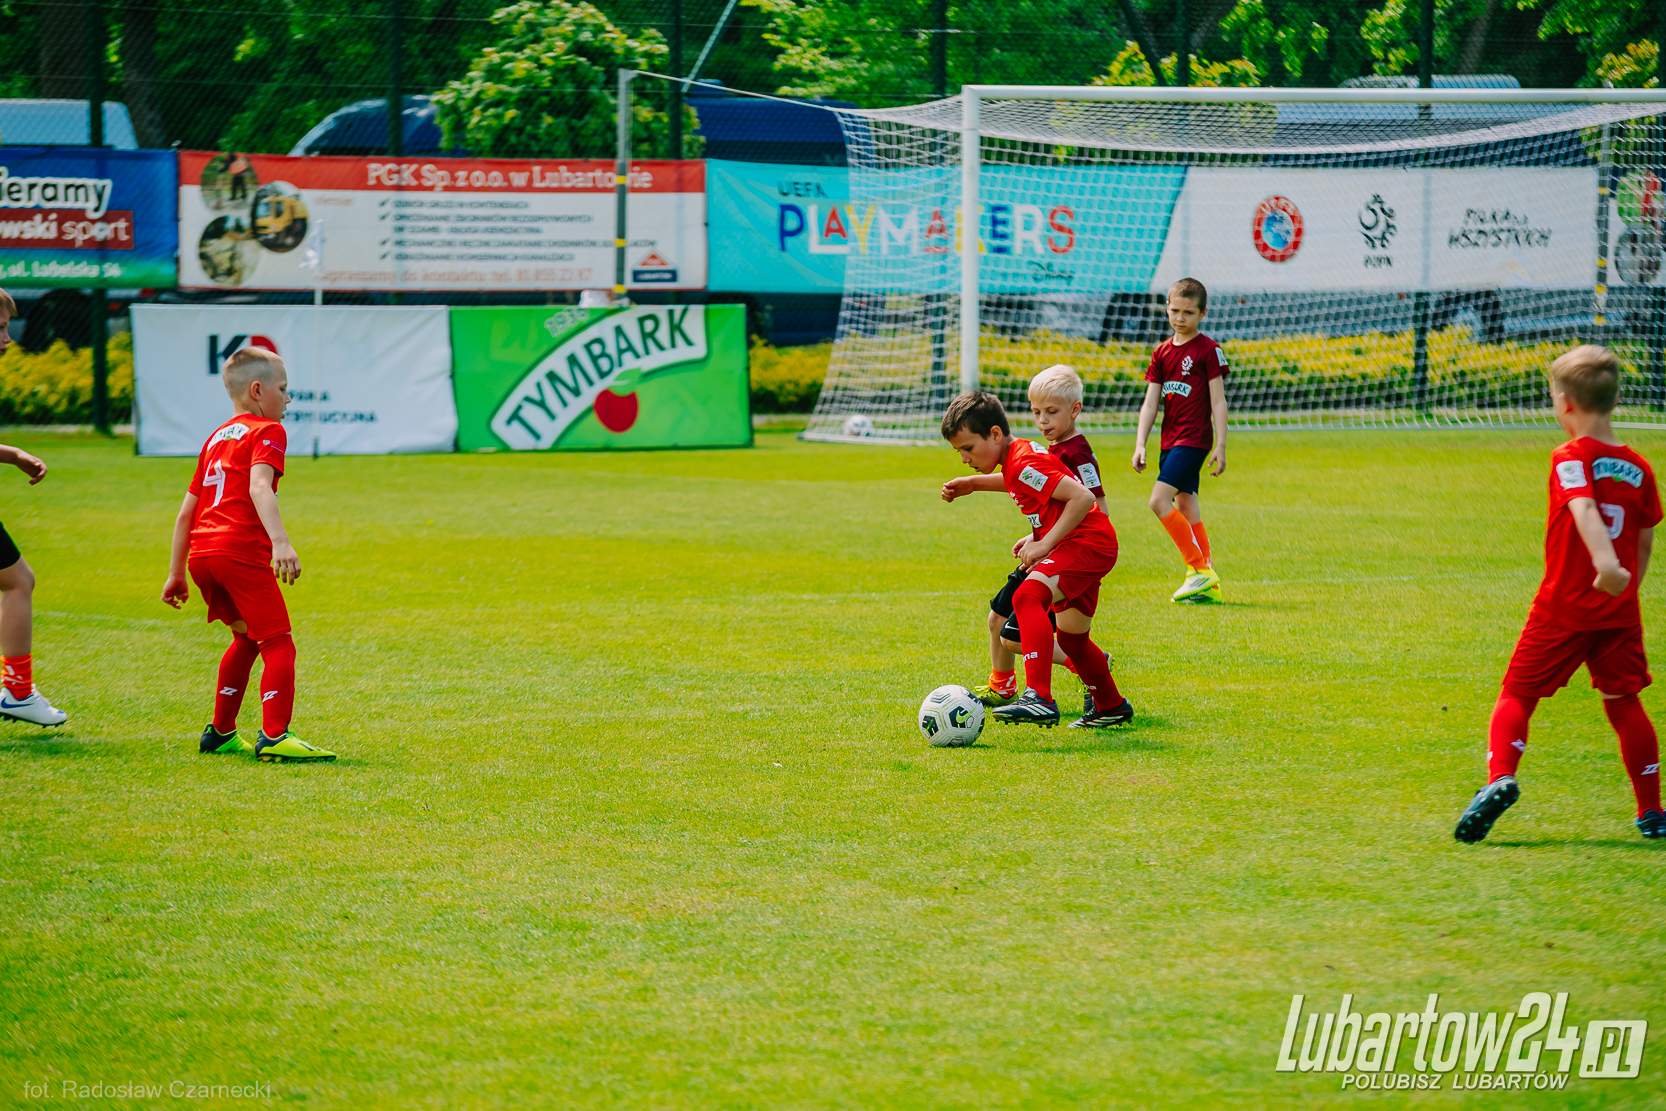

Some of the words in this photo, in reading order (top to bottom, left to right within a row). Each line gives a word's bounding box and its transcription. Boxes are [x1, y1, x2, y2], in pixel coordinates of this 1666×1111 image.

[367, 163, 418, 186] PGK
[509, 171, 529, 188] w
[532, 165, 654, 189] Lubartoie
[777, 182, 827, 198] UEFA
[62, 217, 130, 248] sport
[505, 307, 694, 441] TYMBARK
[203, 458, 225, 507] 4
